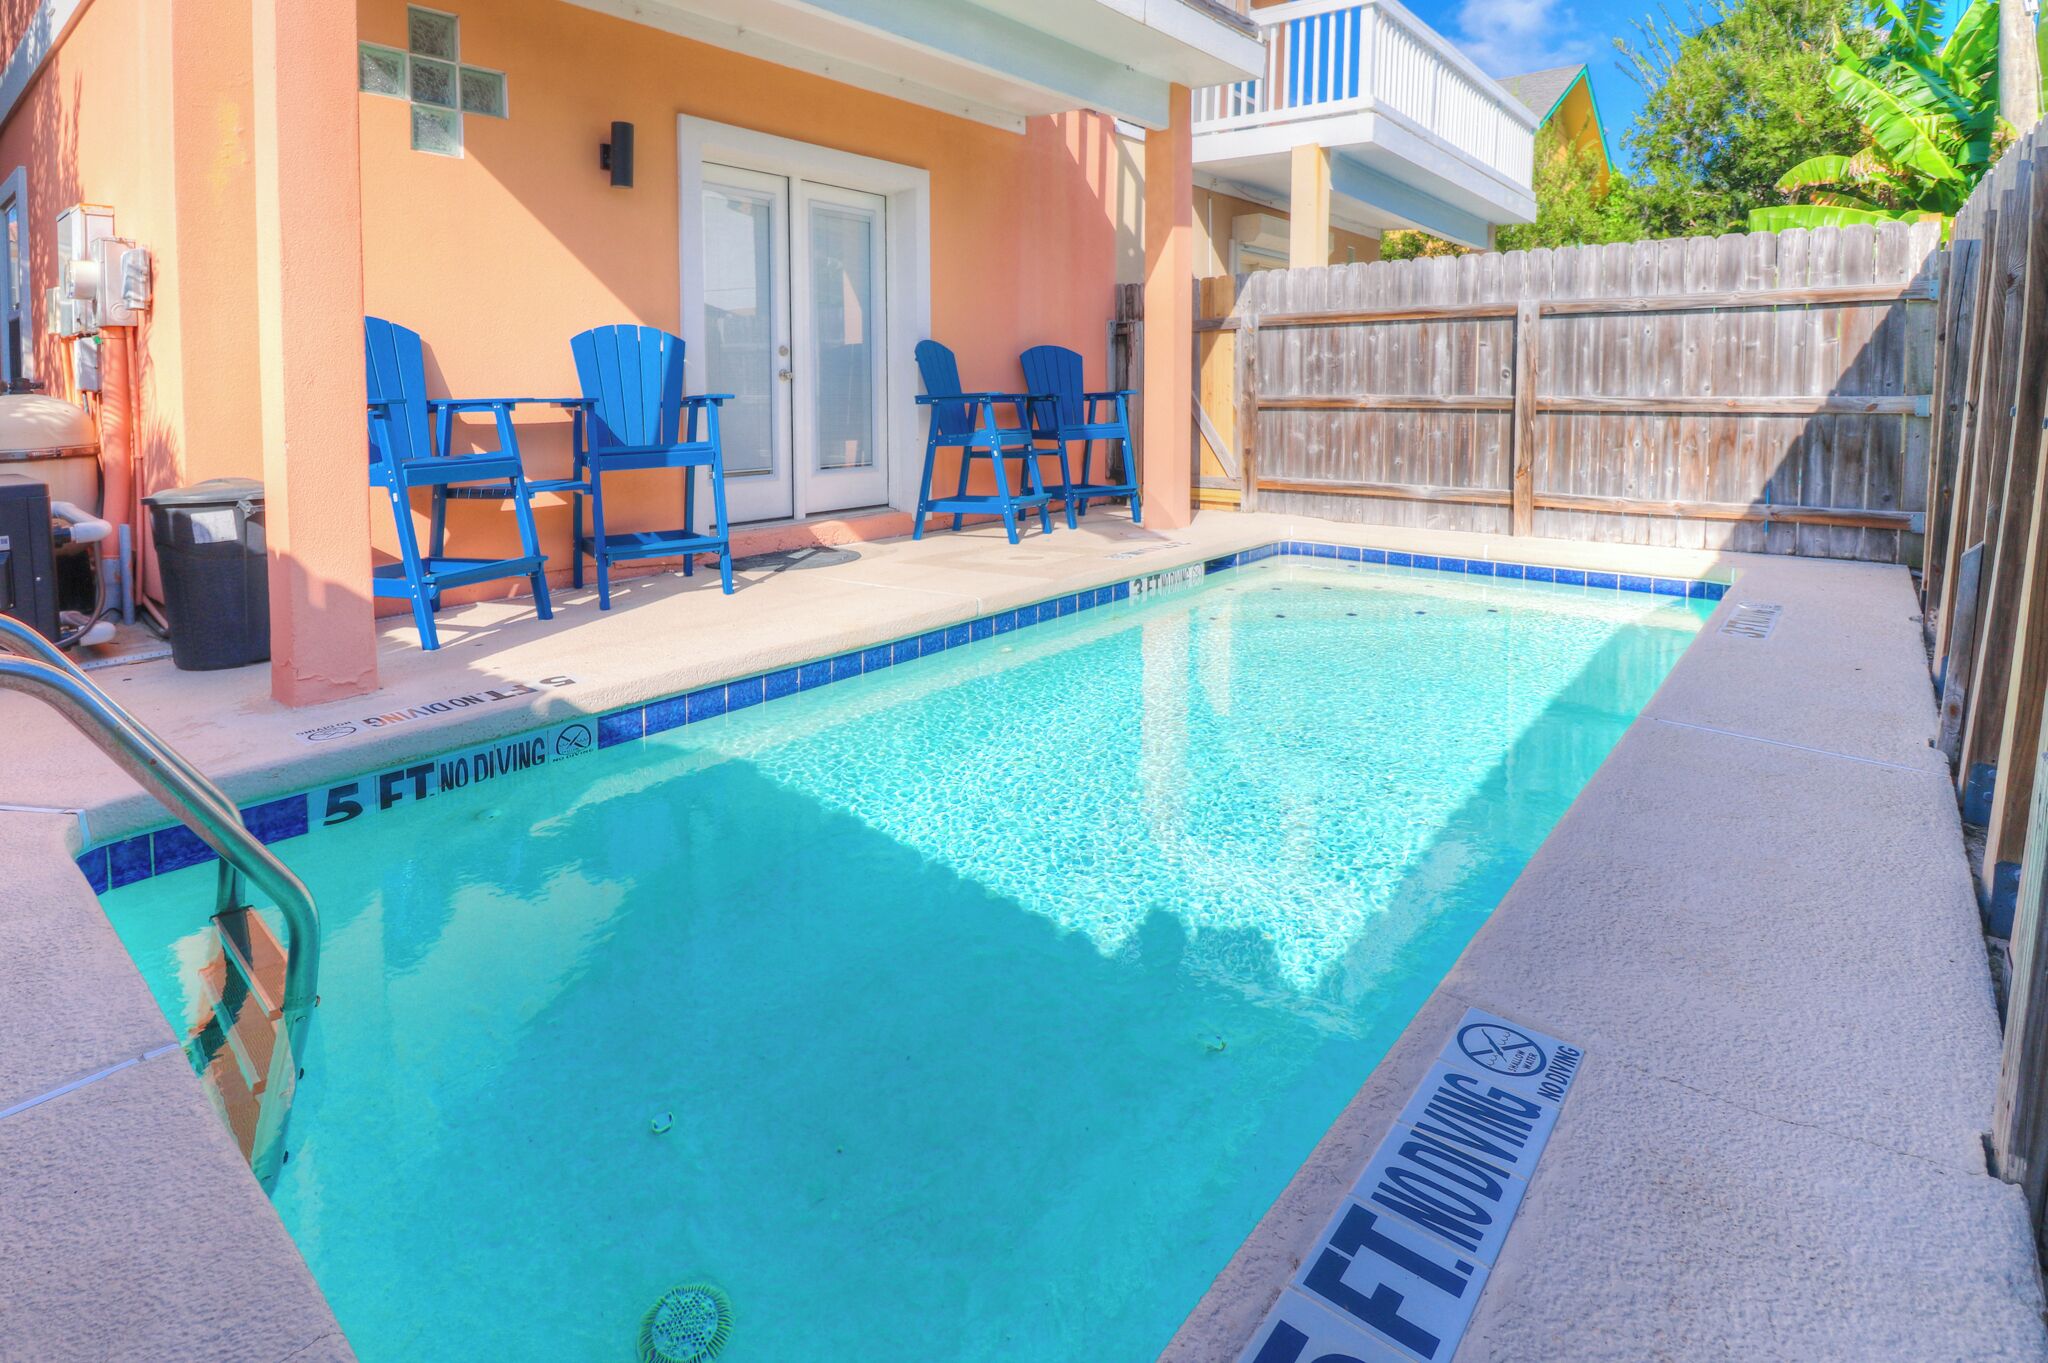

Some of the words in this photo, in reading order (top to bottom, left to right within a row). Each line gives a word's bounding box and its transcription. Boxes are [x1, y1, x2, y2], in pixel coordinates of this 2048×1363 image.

[540, 676, 575, 687] 5
[449, 695, 485, 708] NO
[363, 702, 450, 727] DIVING
[323, 783, 363, 826] 5
[441, 757, 469, 792] NO
[474, 737, 545, 784] DIVING
[1508, 1049, 1525, 1072] SHALLOW
[1524, 1052, 1538, 1070] WATER
[1545, 1045, 1580, 1086] DIVING
[1537, 1081, 1564, 1102] NO
[1398, 1073, 1542, 1202] DIVING
[1370, 1166, 1492, 1253] NO
[1303, 1203, 1475, 1360] FT.
